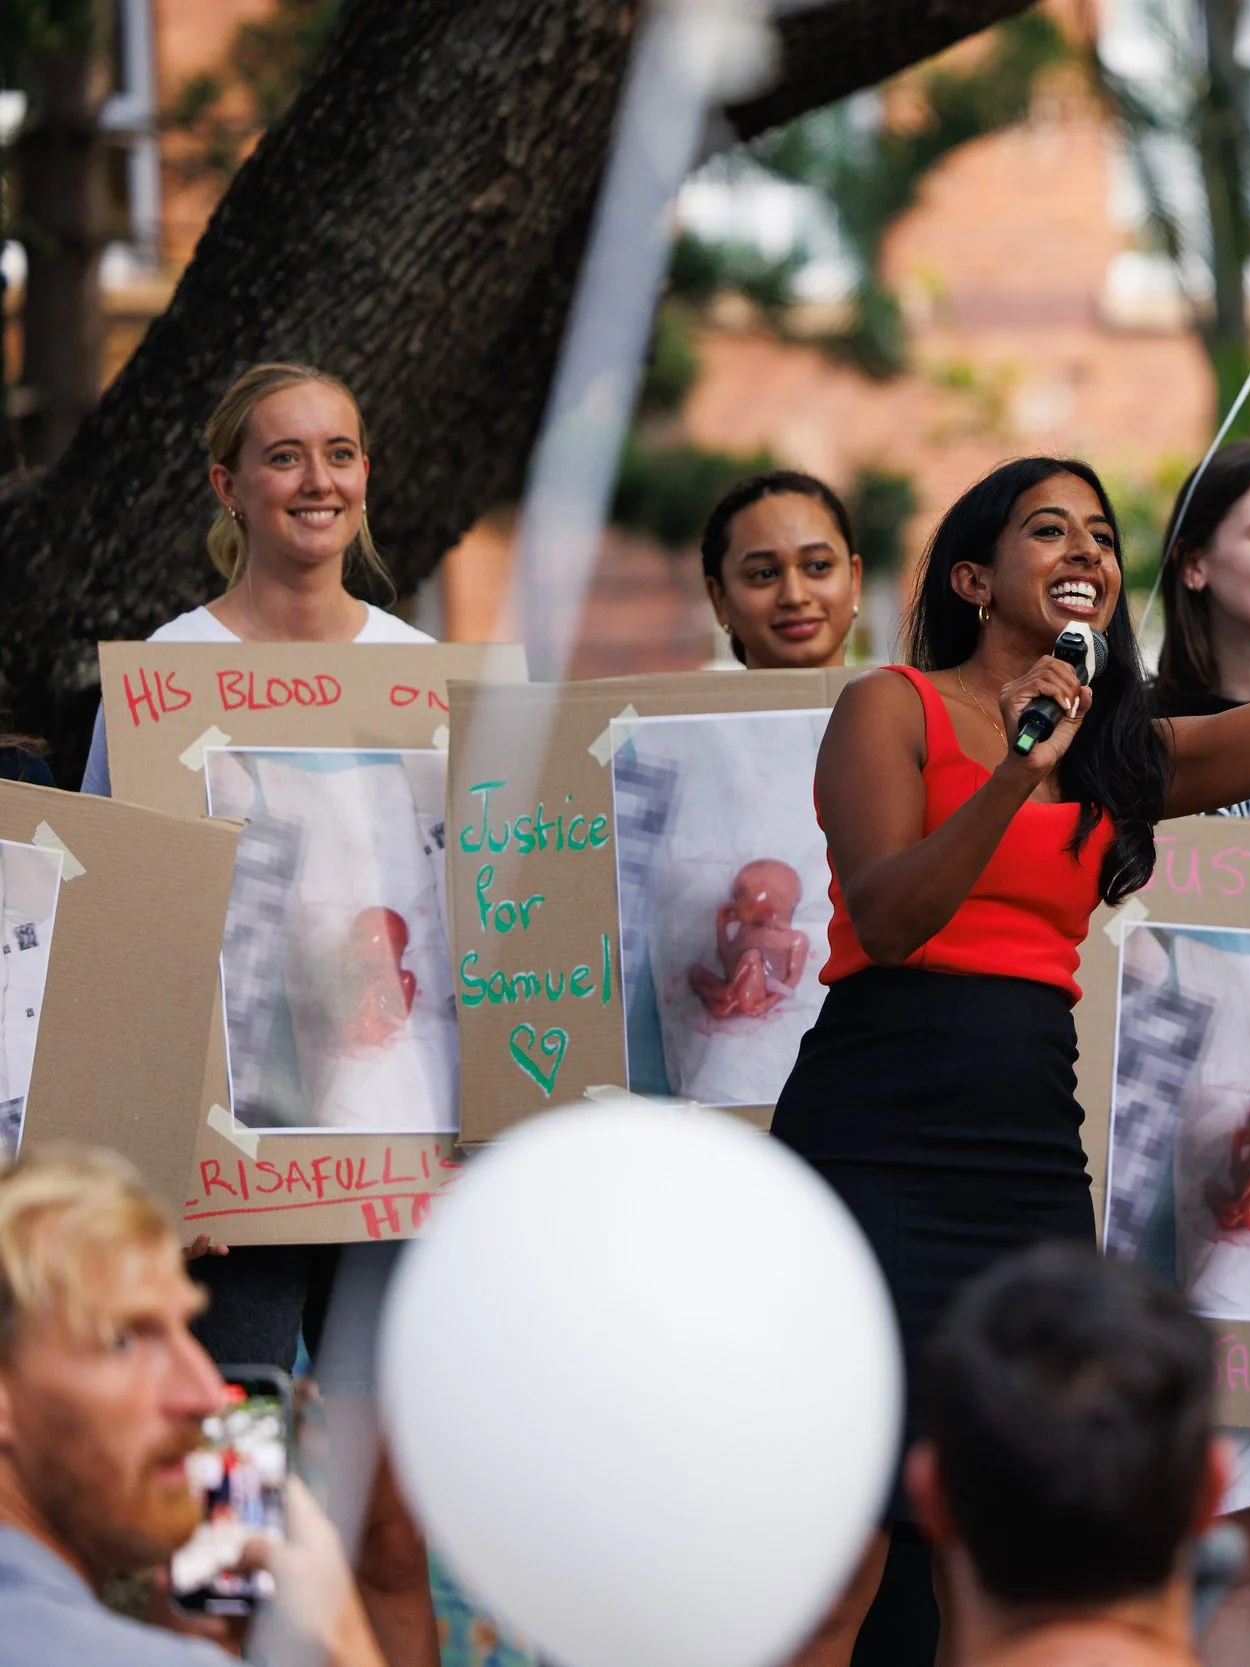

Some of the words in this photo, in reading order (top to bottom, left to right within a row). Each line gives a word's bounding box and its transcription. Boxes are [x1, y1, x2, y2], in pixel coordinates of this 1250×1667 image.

[122, 667, 192, 727] HIS
[215, 670, 342, 711] BLOOD
[459, 780, 610, 854] Justice
[476, 864, 545, 933] for
[459, 934, 612, 1007] Samuel
[184, 1142, 466, 1207] RISAFULLI'S
